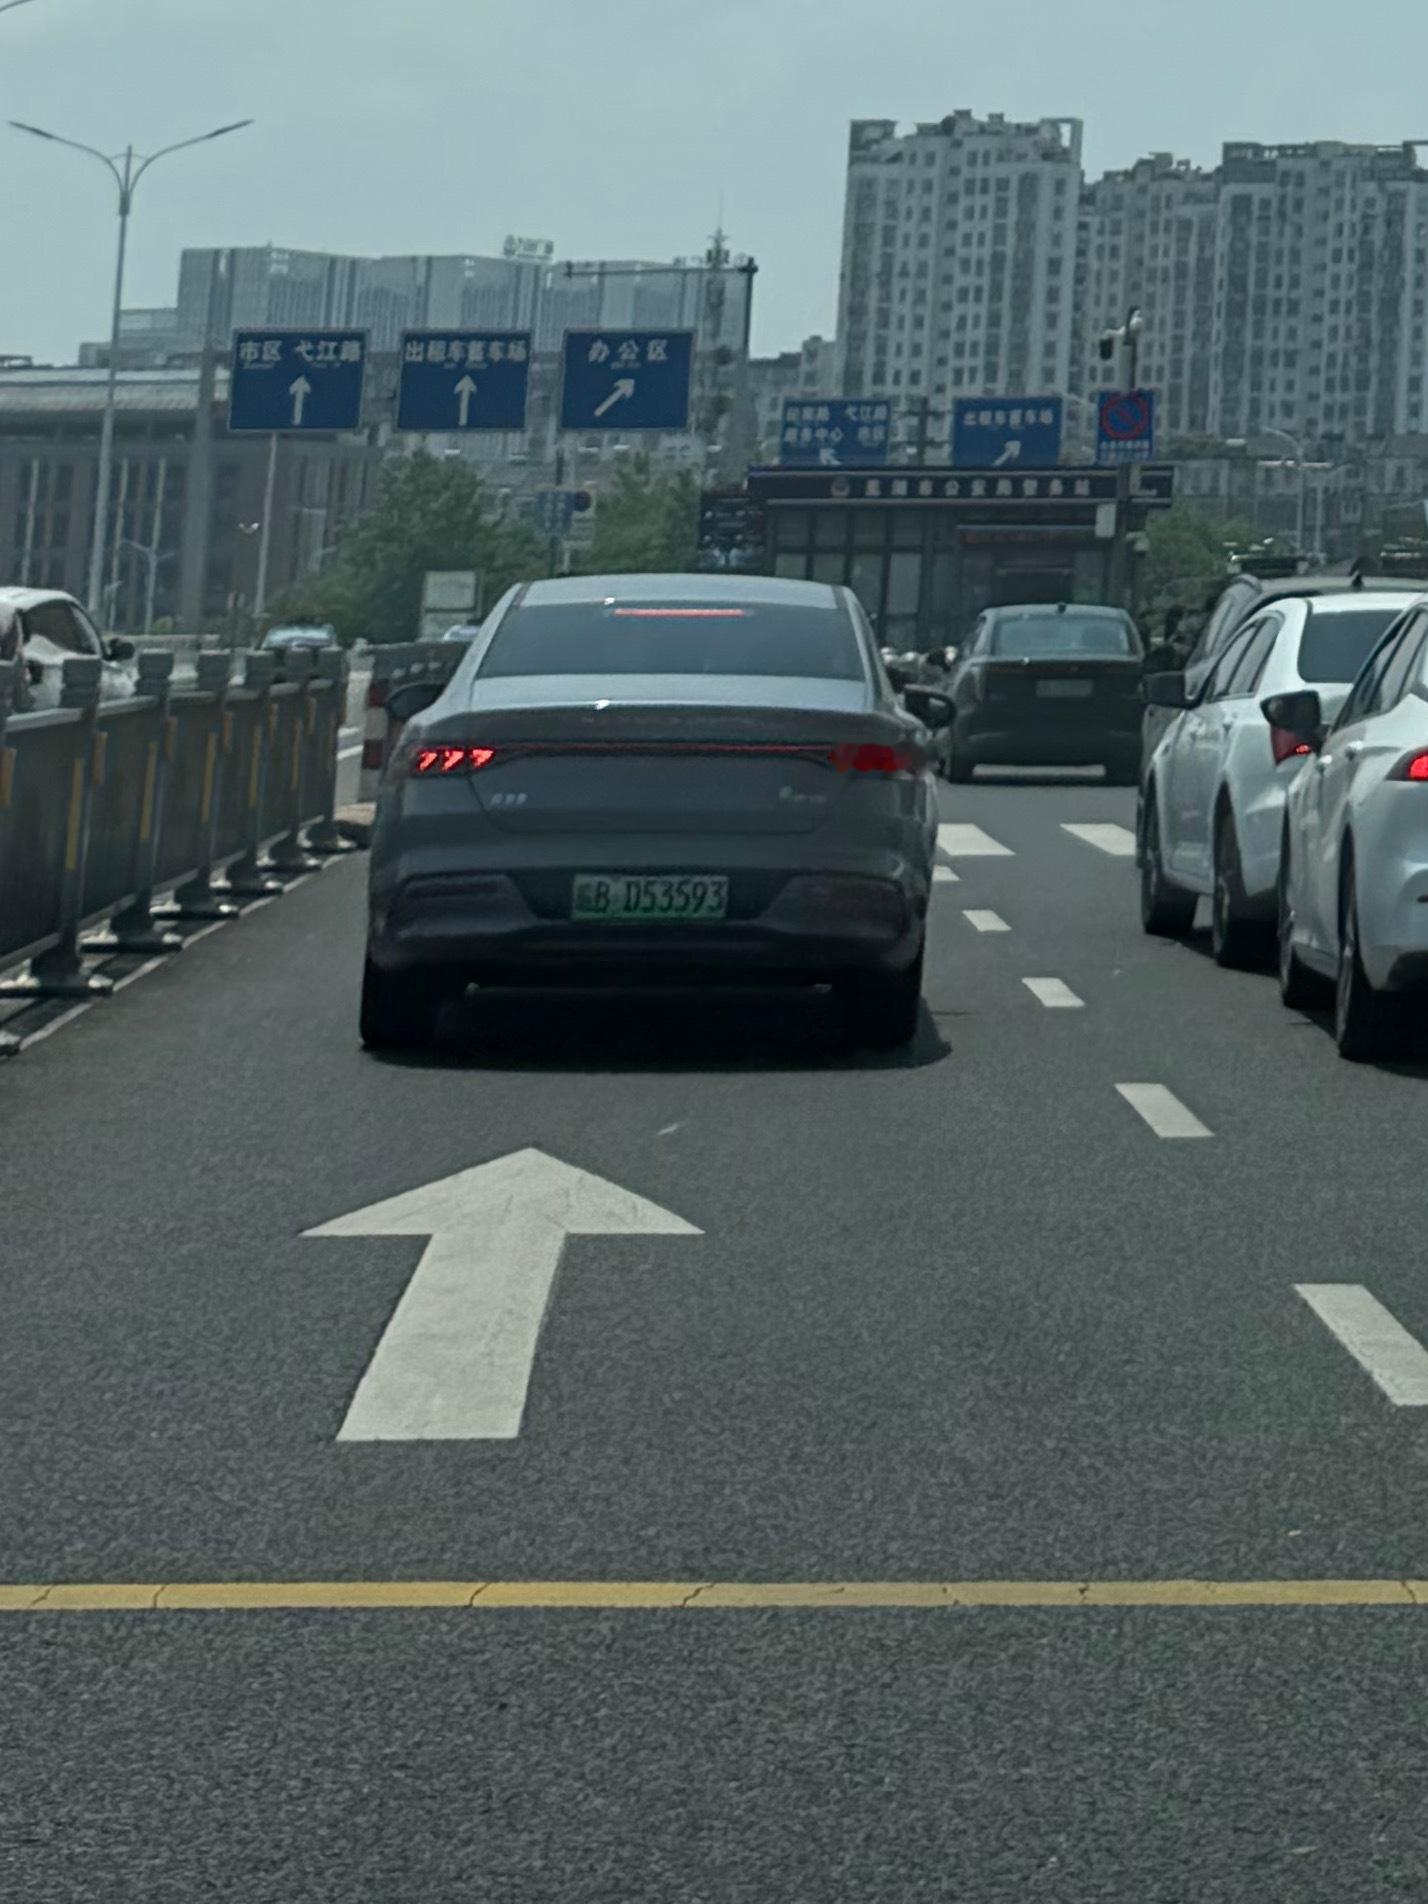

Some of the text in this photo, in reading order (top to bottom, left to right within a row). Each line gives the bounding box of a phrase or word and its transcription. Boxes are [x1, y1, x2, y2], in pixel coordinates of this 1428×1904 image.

[239, 340, 282, 362] 市区
[588, 339, 668, 363] 办公区
